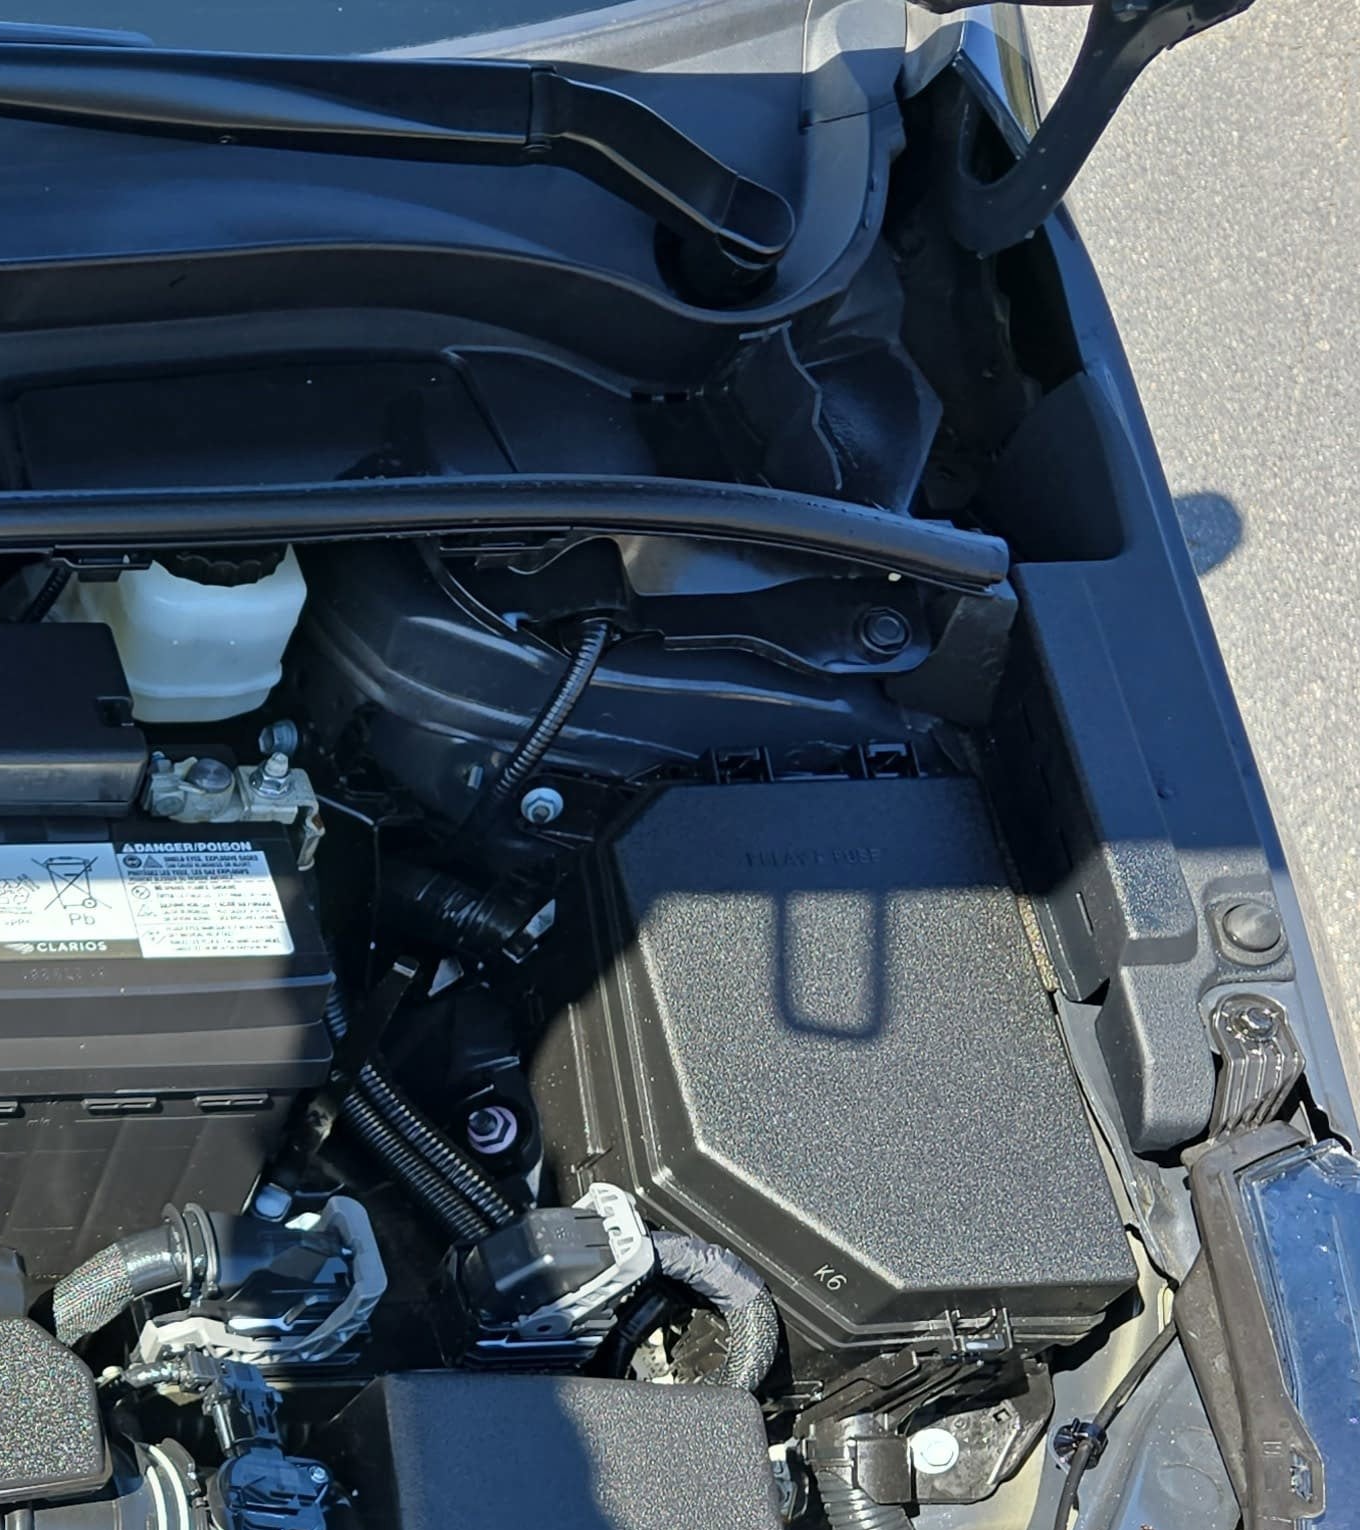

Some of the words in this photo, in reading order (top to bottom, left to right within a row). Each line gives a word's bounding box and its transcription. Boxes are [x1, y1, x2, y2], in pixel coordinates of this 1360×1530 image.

[133, 841, 252, 853] DANGER/POISON
[69, 912, 96, 926] Pb
[36, 941, 108, 953] CLARIOS
[813, 1264, 847, 1290] K6
